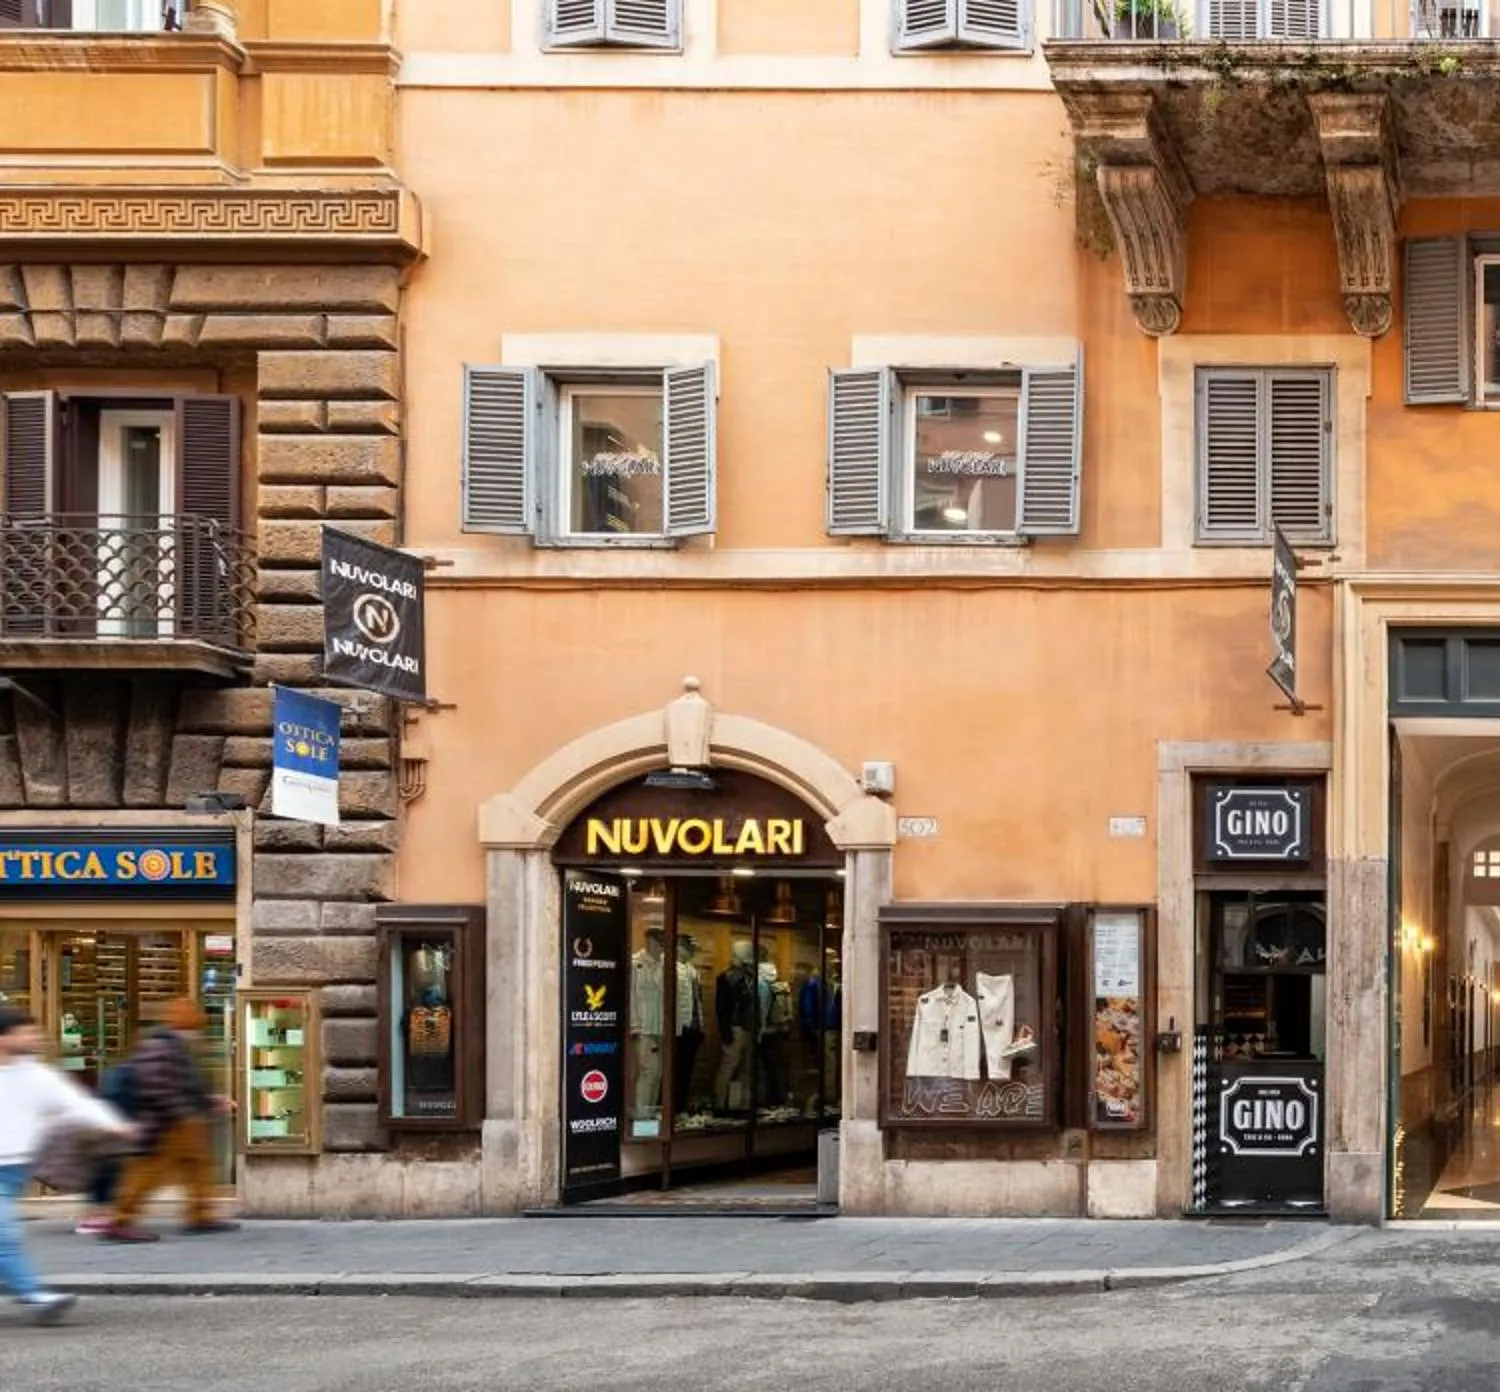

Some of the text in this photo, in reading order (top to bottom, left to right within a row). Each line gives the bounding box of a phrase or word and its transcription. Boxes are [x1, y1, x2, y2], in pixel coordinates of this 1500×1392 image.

[331, 558, 416, 599] NUVOLARI
[365, 604, 389, 633] N
[333, 637, 419, 674] NUVOLARI
[279, 721, 335, 746] OTTICA
[286, 738, 328, 761] SOLE
[586, 818, 804, 855] NUVOLARI
[1227, 809, 1289, 837] GINO
[0, 850, 218, 880] TTICA SOLE
[902, 1081, 969, 1114] WE
[1233, 1099, 1305, 1130] GINO
